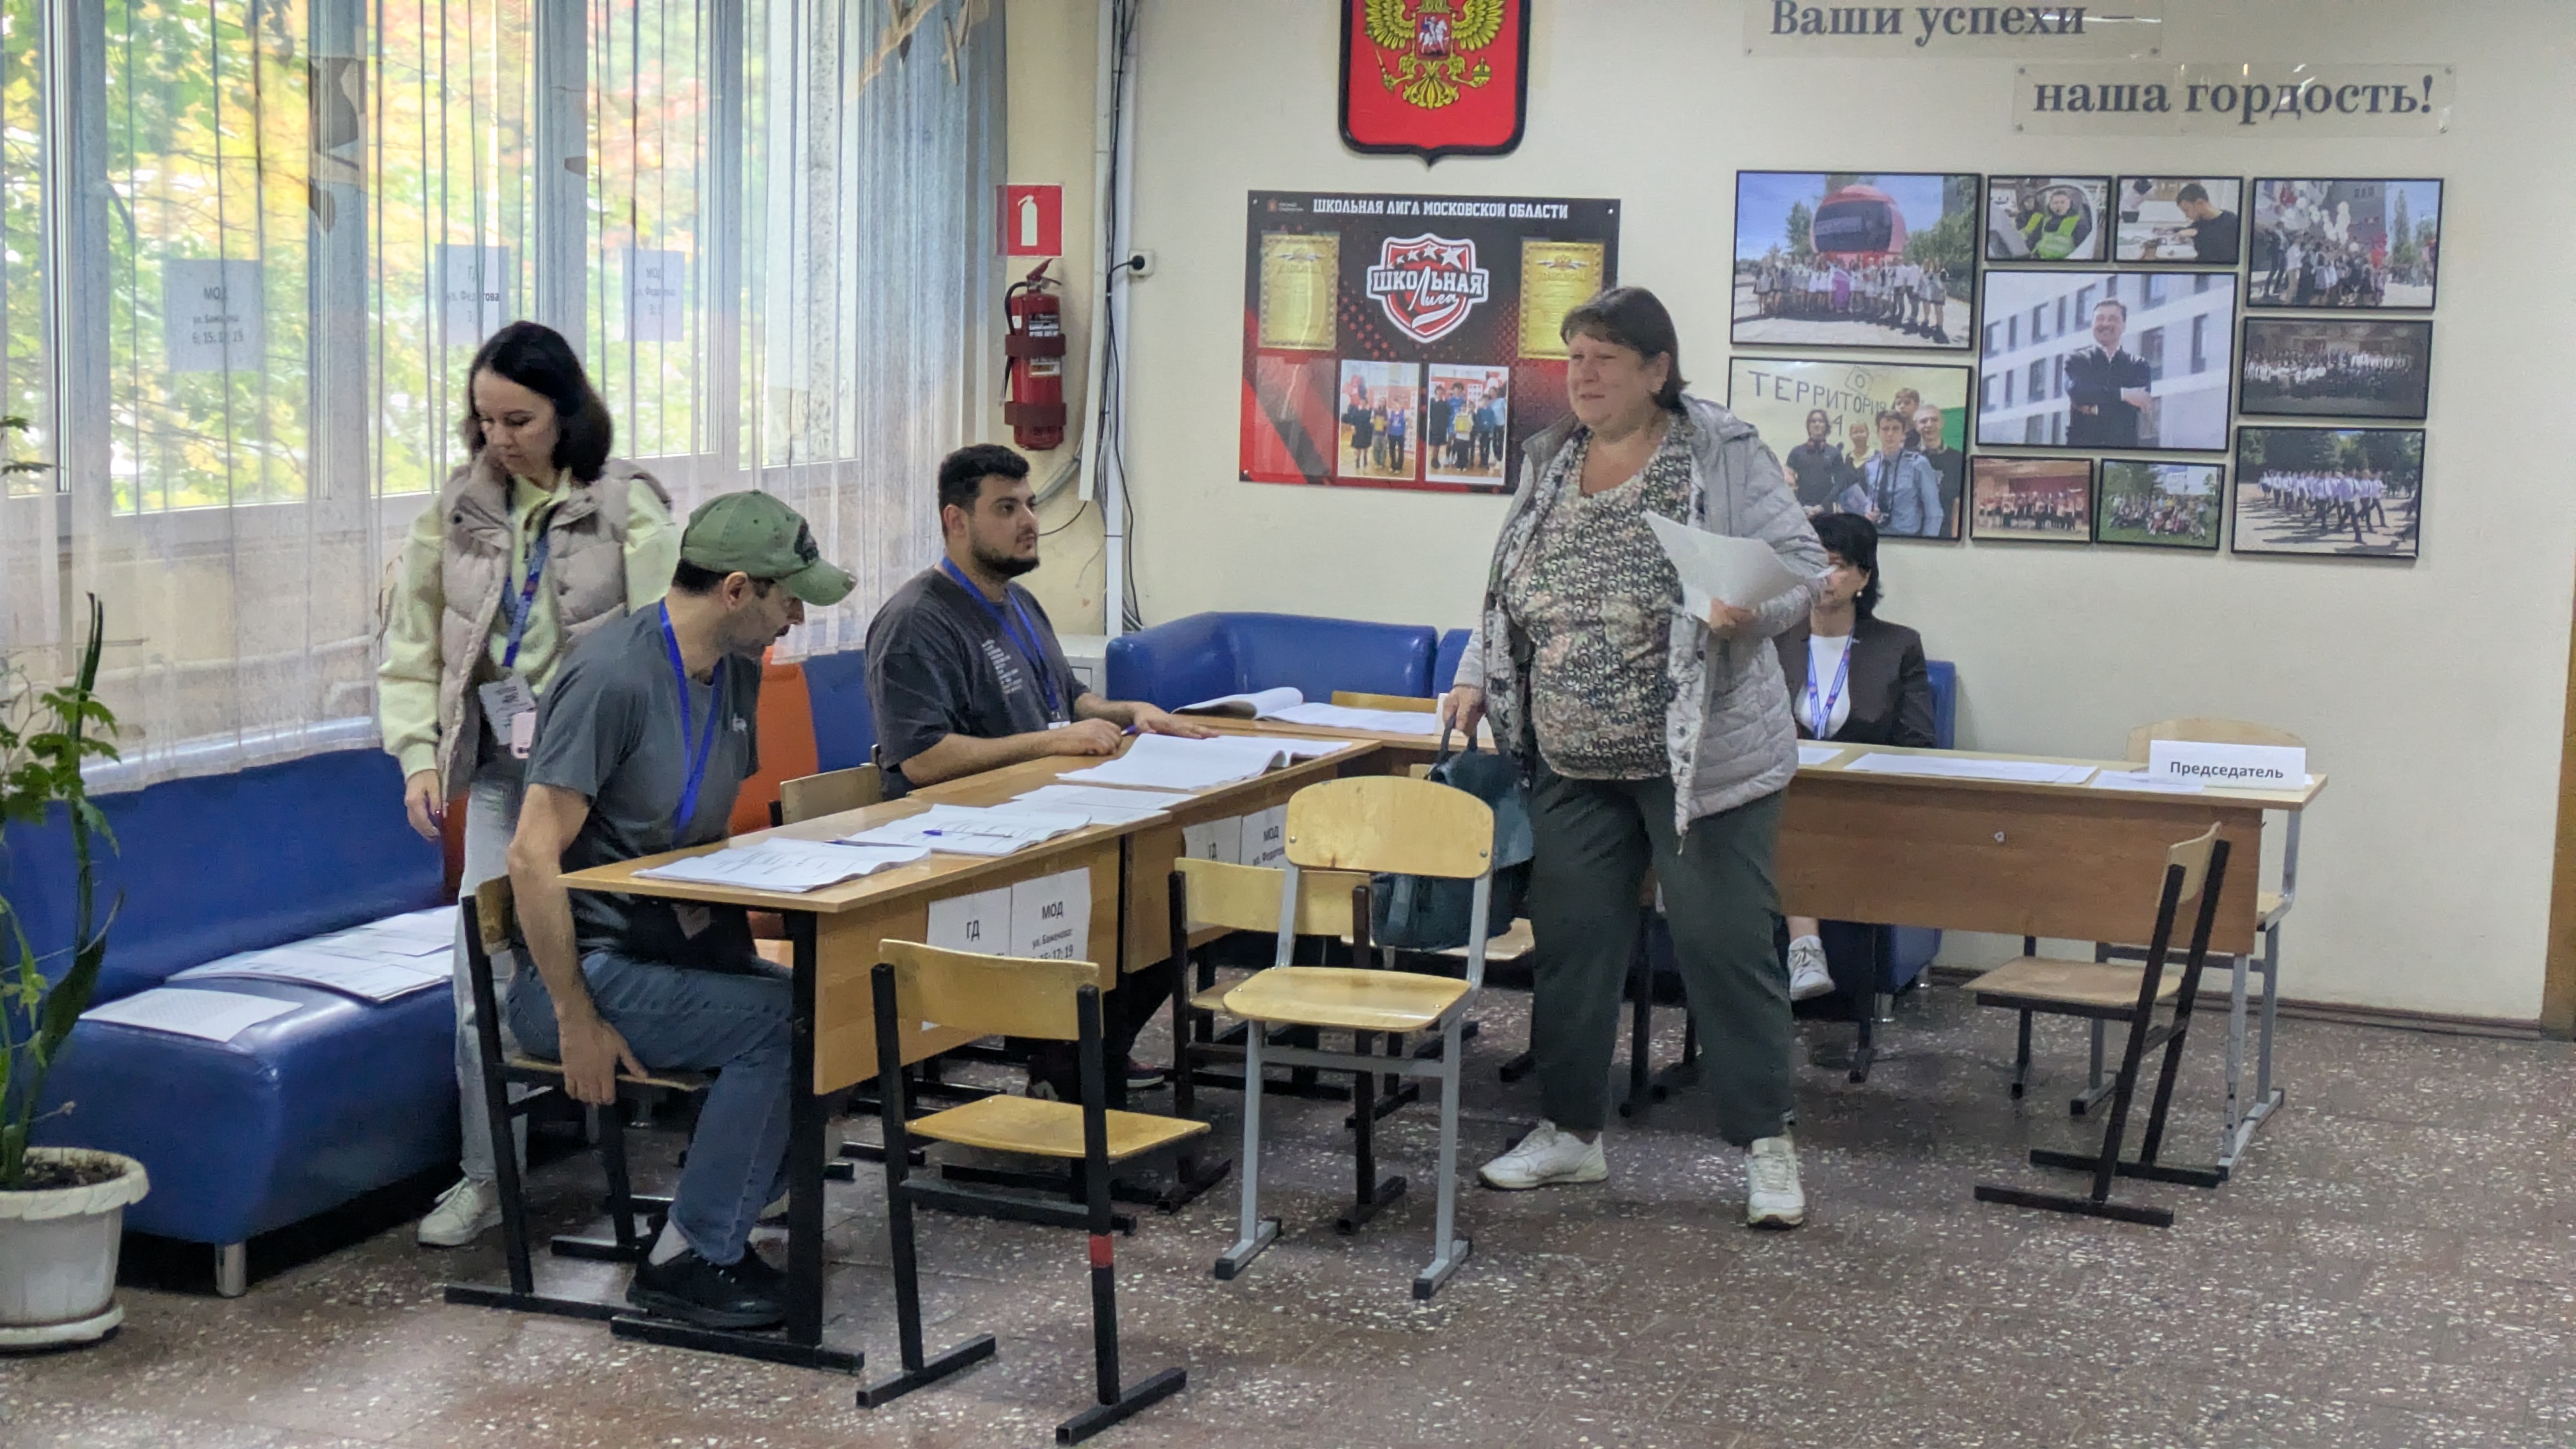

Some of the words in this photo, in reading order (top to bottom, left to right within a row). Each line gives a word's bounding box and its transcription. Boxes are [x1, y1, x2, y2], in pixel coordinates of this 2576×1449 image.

[1770, 0, 1903, 35] Ваши
[1915, 6, 2087, 47] успехи
[2033, 83, 2171, 113] наша
[2184, 74, 2434, 125] гордость!
[1313, 198, 1384, 215] ШКОЛЬНАЯ
[1386, 201, 1420, 215] ЛИГА
[1508, 203, 1568, 219] ОБЛАСТИ
[1373, 267, 1483, 296] ШКОЛЬНАЯ
[1407, 266, 1460, 311] Лига
[2170, 762, 2284, 779] Председатель
[1042, 901, 1064, 919] МОД
[967, 920, 979, 942] ГД
[1065, 944, 1073, 958] 19
